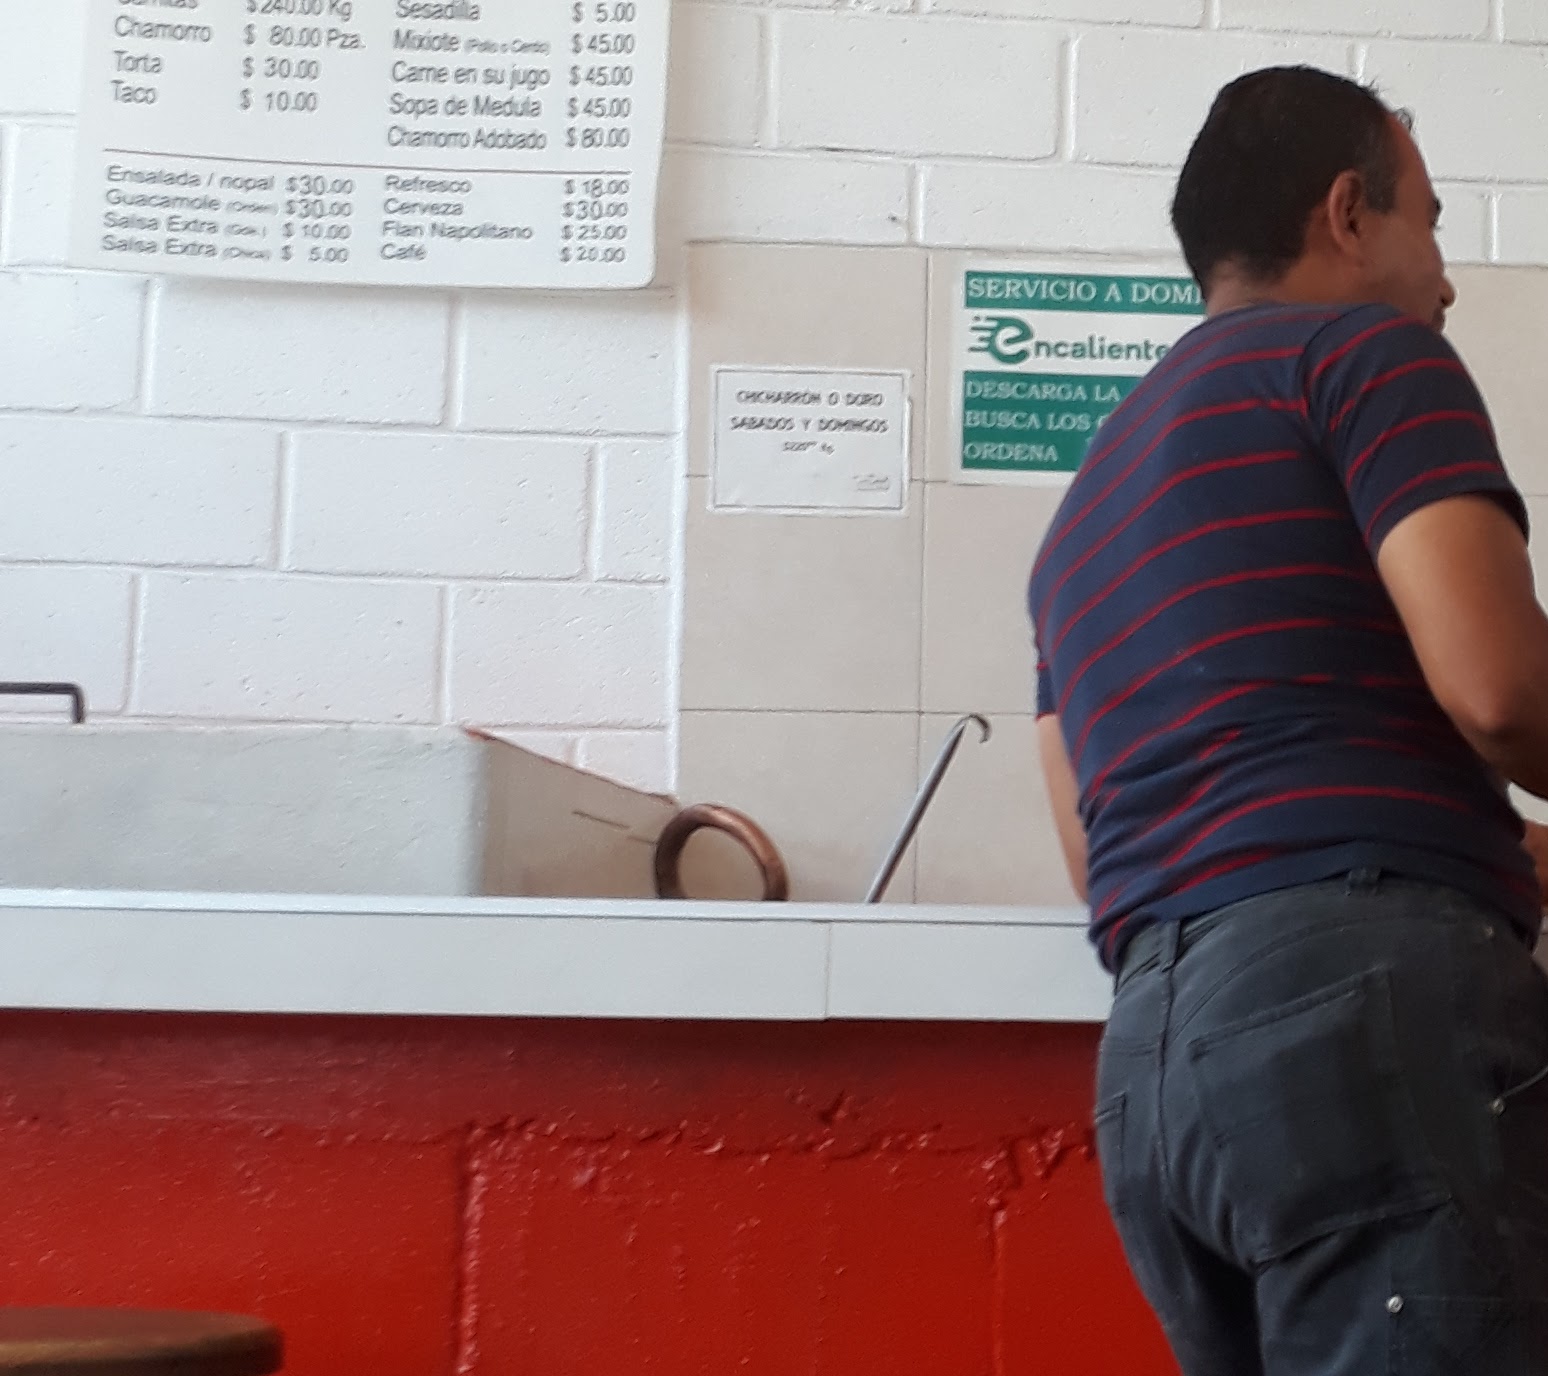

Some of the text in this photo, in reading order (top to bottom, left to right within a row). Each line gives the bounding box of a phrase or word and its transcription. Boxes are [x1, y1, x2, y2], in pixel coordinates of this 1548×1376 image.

[115, 16, 211, 42] Chamorro
[394, 29, 459, 52] Mixiote
[114, 50, 162, 73] Torta
[392, 61, 449, 84] Carne
[455, 67, 477, 84] en
[483, 67, 506, 85] su
[509, 65, 550, 91] jugo
[110, 79, 156, 104] Taco
[389, 92, 439, 120] Sopa
[444, 96, 469, 116] de
[388, 125, 470, 149] Chamorro
[107, 165, 201, 186] Ensalada
[220, 176, 274, 192] nopal
[384, 175, 472, 194] Refresco
[106, 188, 220, 210] Guacamole
[384, 198, 464, 216] Cerveza
[104, 212, 159, 230] Salsa
[167, 216, 218, 234] Extra
[382, 221, 425, 238] Flan
[102, 235, 156, 253] Salsa
[165, 238, 217, 257] Extra
[967, 278, 1097, 302] SERVICIO
[1104, 283, 1122, 304] A
[965, 380, 1121, 402] DESCARGA LA
[965, 410, 1040, 429] BUSCA
[1048, 413, 1091, 431] LOS
[964, 442, 1058, 462] ORDENA
